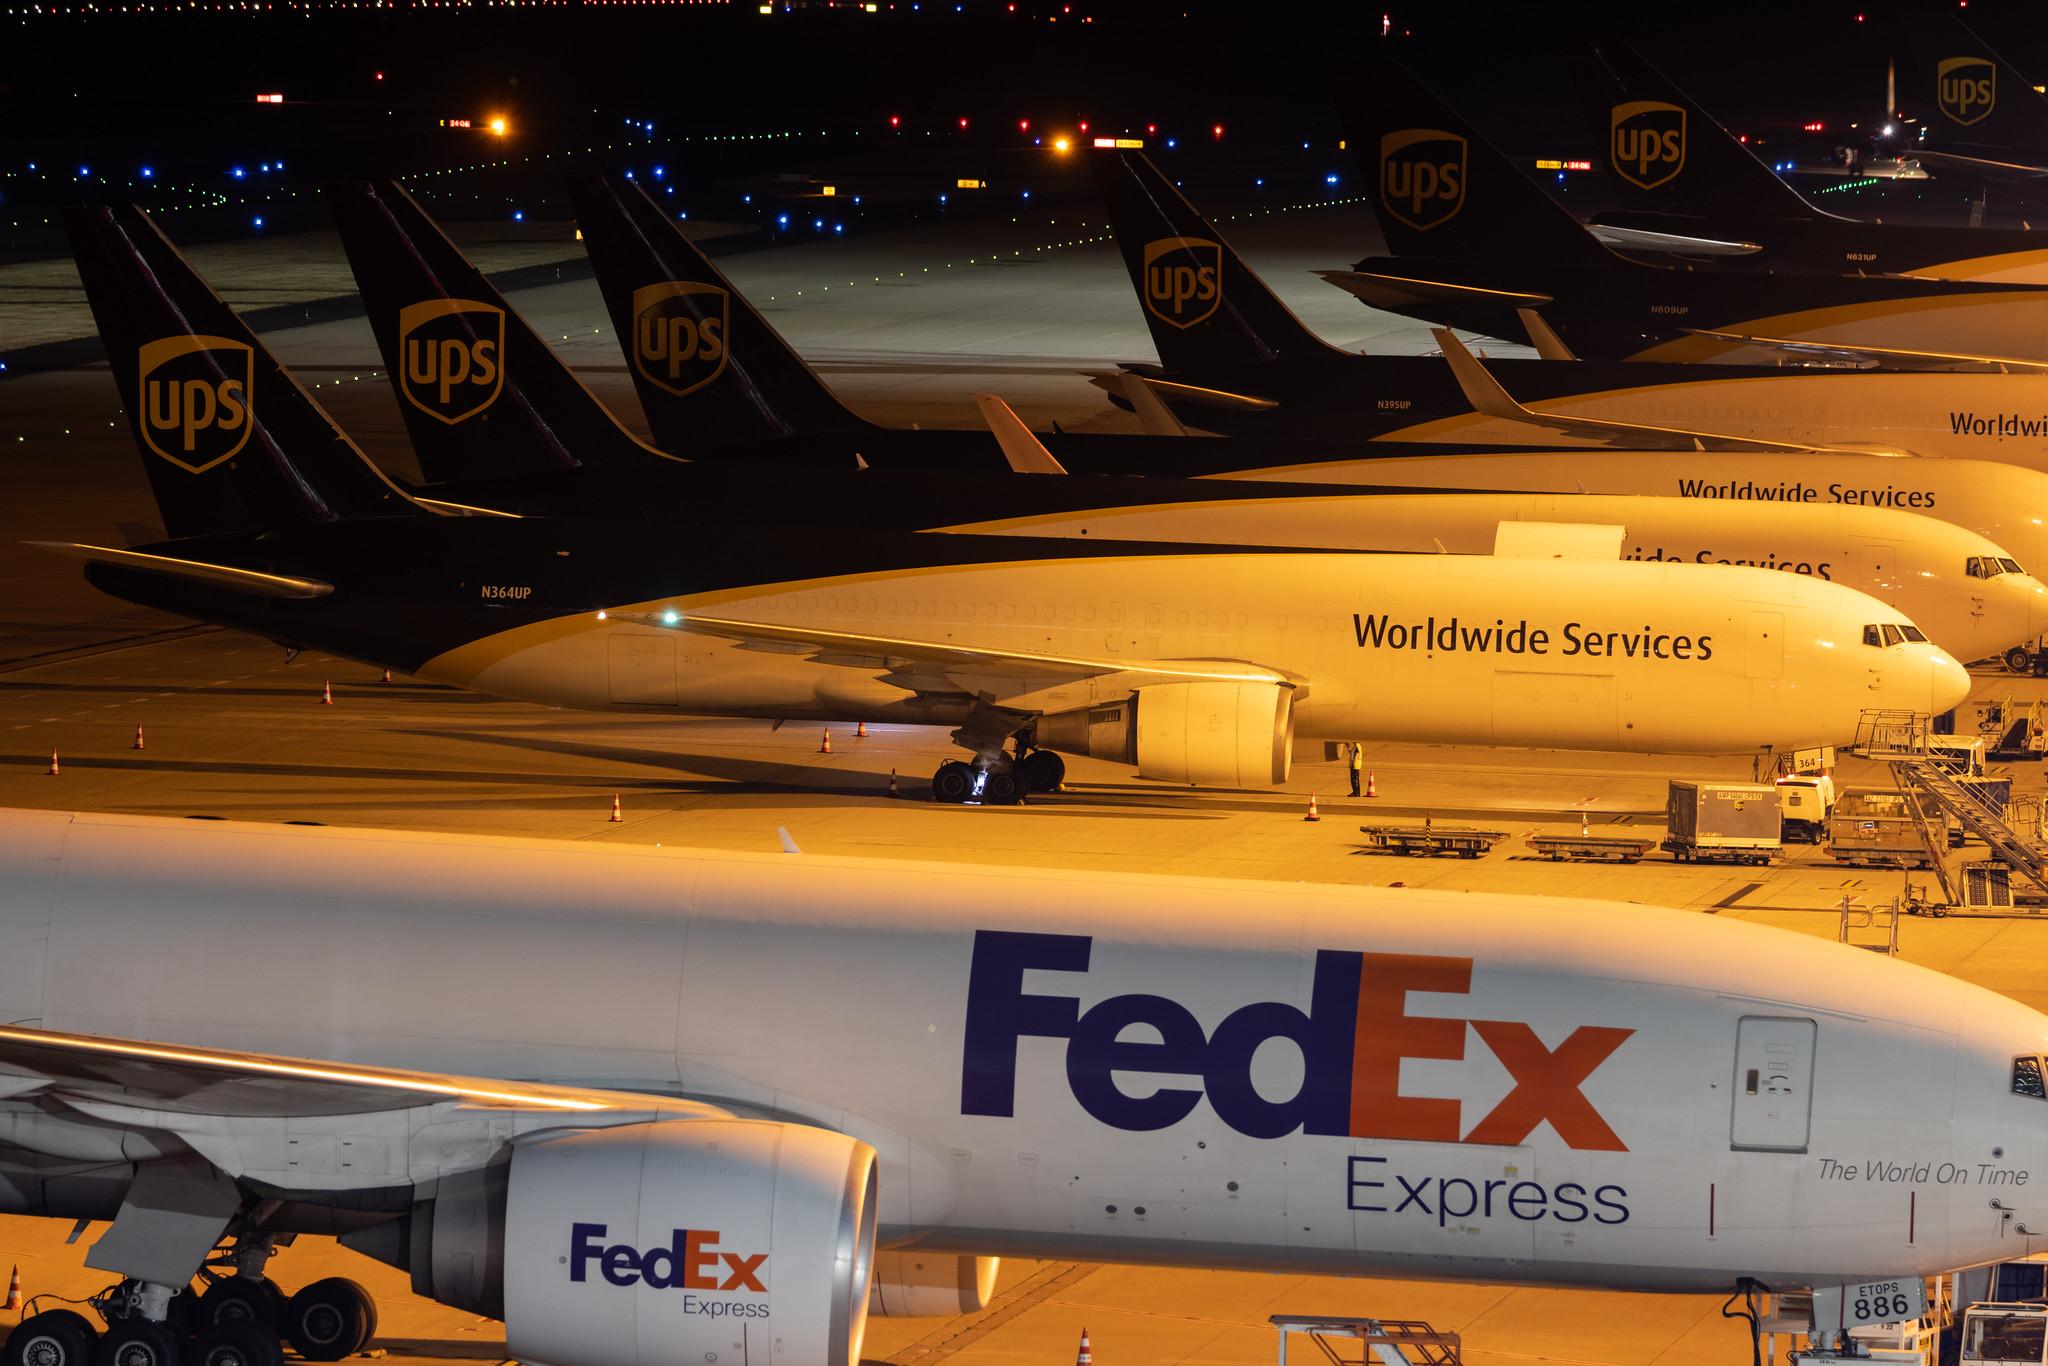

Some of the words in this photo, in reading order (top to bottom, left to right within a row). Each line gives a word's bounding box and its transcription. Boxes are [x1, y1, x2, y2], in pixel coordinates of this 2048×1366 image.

[1942, 77, 1990, 114] ups
[1617, 126, 1679, 175] ups
[1387, 160, 1460, 214] ups
[1150, 264, 1216, 314] ups
[408, 336, 497, 405] ups
[641, 313, 723, 380] ups
[148, 379, 246, 452] ups
[1377, 399, 1412, 409] N395UP
[1678, 479, 1818, 503] Worldwide
[1828, 483, 1936, 508] Services
[481, 585, 532, 600] N364UP
[1353, 613, 1550, 656] Worldwide
[1562, 622, 1713, 661] Services
[1799, 758, 1815, 768] 364
[960, 929, 1638, 1153] FedEx
[1346, 1155, 1630, 1227] Express
[1819, 1158, 1858, 1181] The
[1866, 1160, 1931, 1184] World
[1936, 1162, 1968, 1184] On
[1977, 1164, 2029, 1186] Time
[569, 1222, 770, 1293] FedEx
[683, 1295, 770, 1319] Express
[1854, 1294, 1909, 1321] 886
[1859, 1282, 1899, 1297] ETOPS
